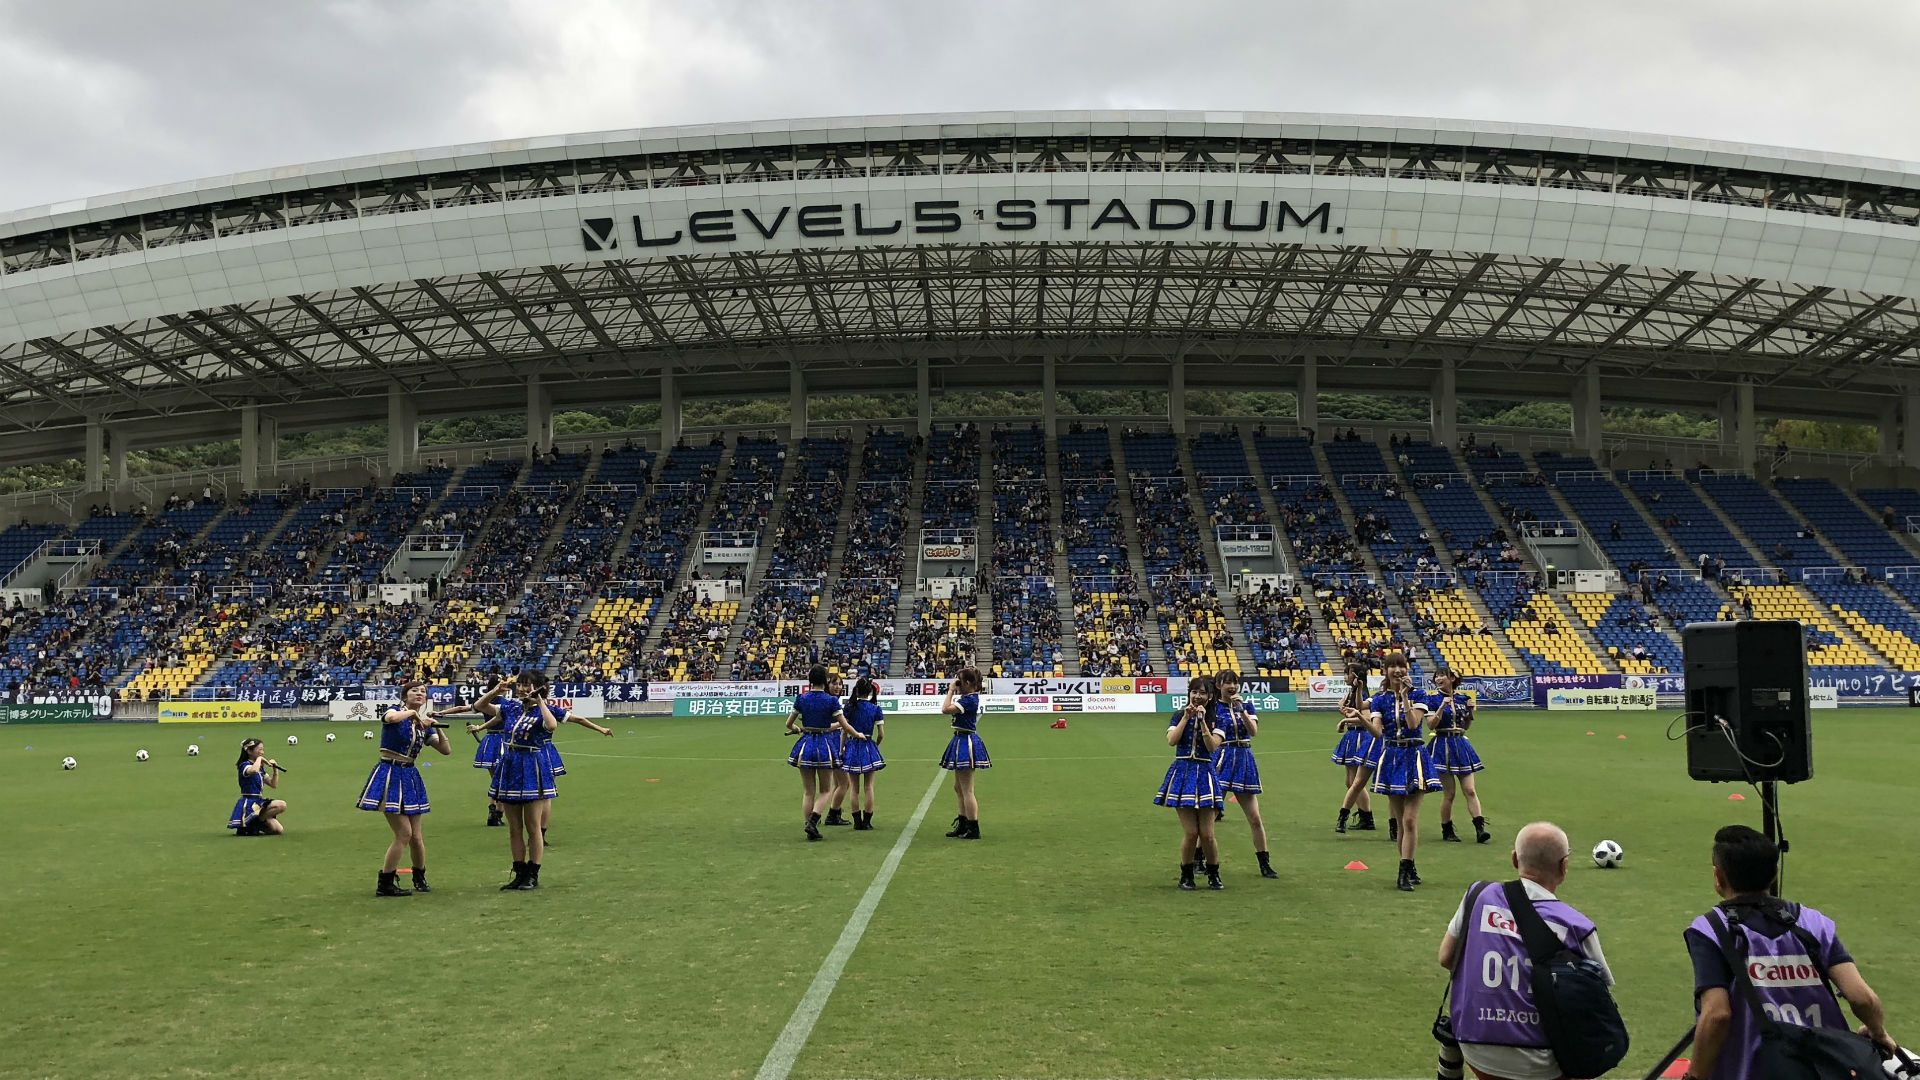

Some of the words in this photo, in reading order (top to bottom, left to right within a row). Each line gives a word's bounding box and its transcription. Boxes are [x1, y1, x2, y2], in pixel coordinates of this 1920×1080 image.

[996, 198, 1344, 235] STADIUM.
[925, 546, 961, 557] セイワパーク
[590, 685, 643, 701] 城後寿
[1013, 678, 1100, 695] スポーツくじ
[1237, 682, 1270, 693] AZN
[237, 689, 297, 704] 枝村匠馬
[301, 687, 361, 702] 駒野友一
[1586, 695, 1619, 705] 自転車は
[1620, 694, 1654, 705] 左側通行
[9, 709, 91, 720] 博多グリーンホテル
[689, 699, 796, 715] 明治安田生命
